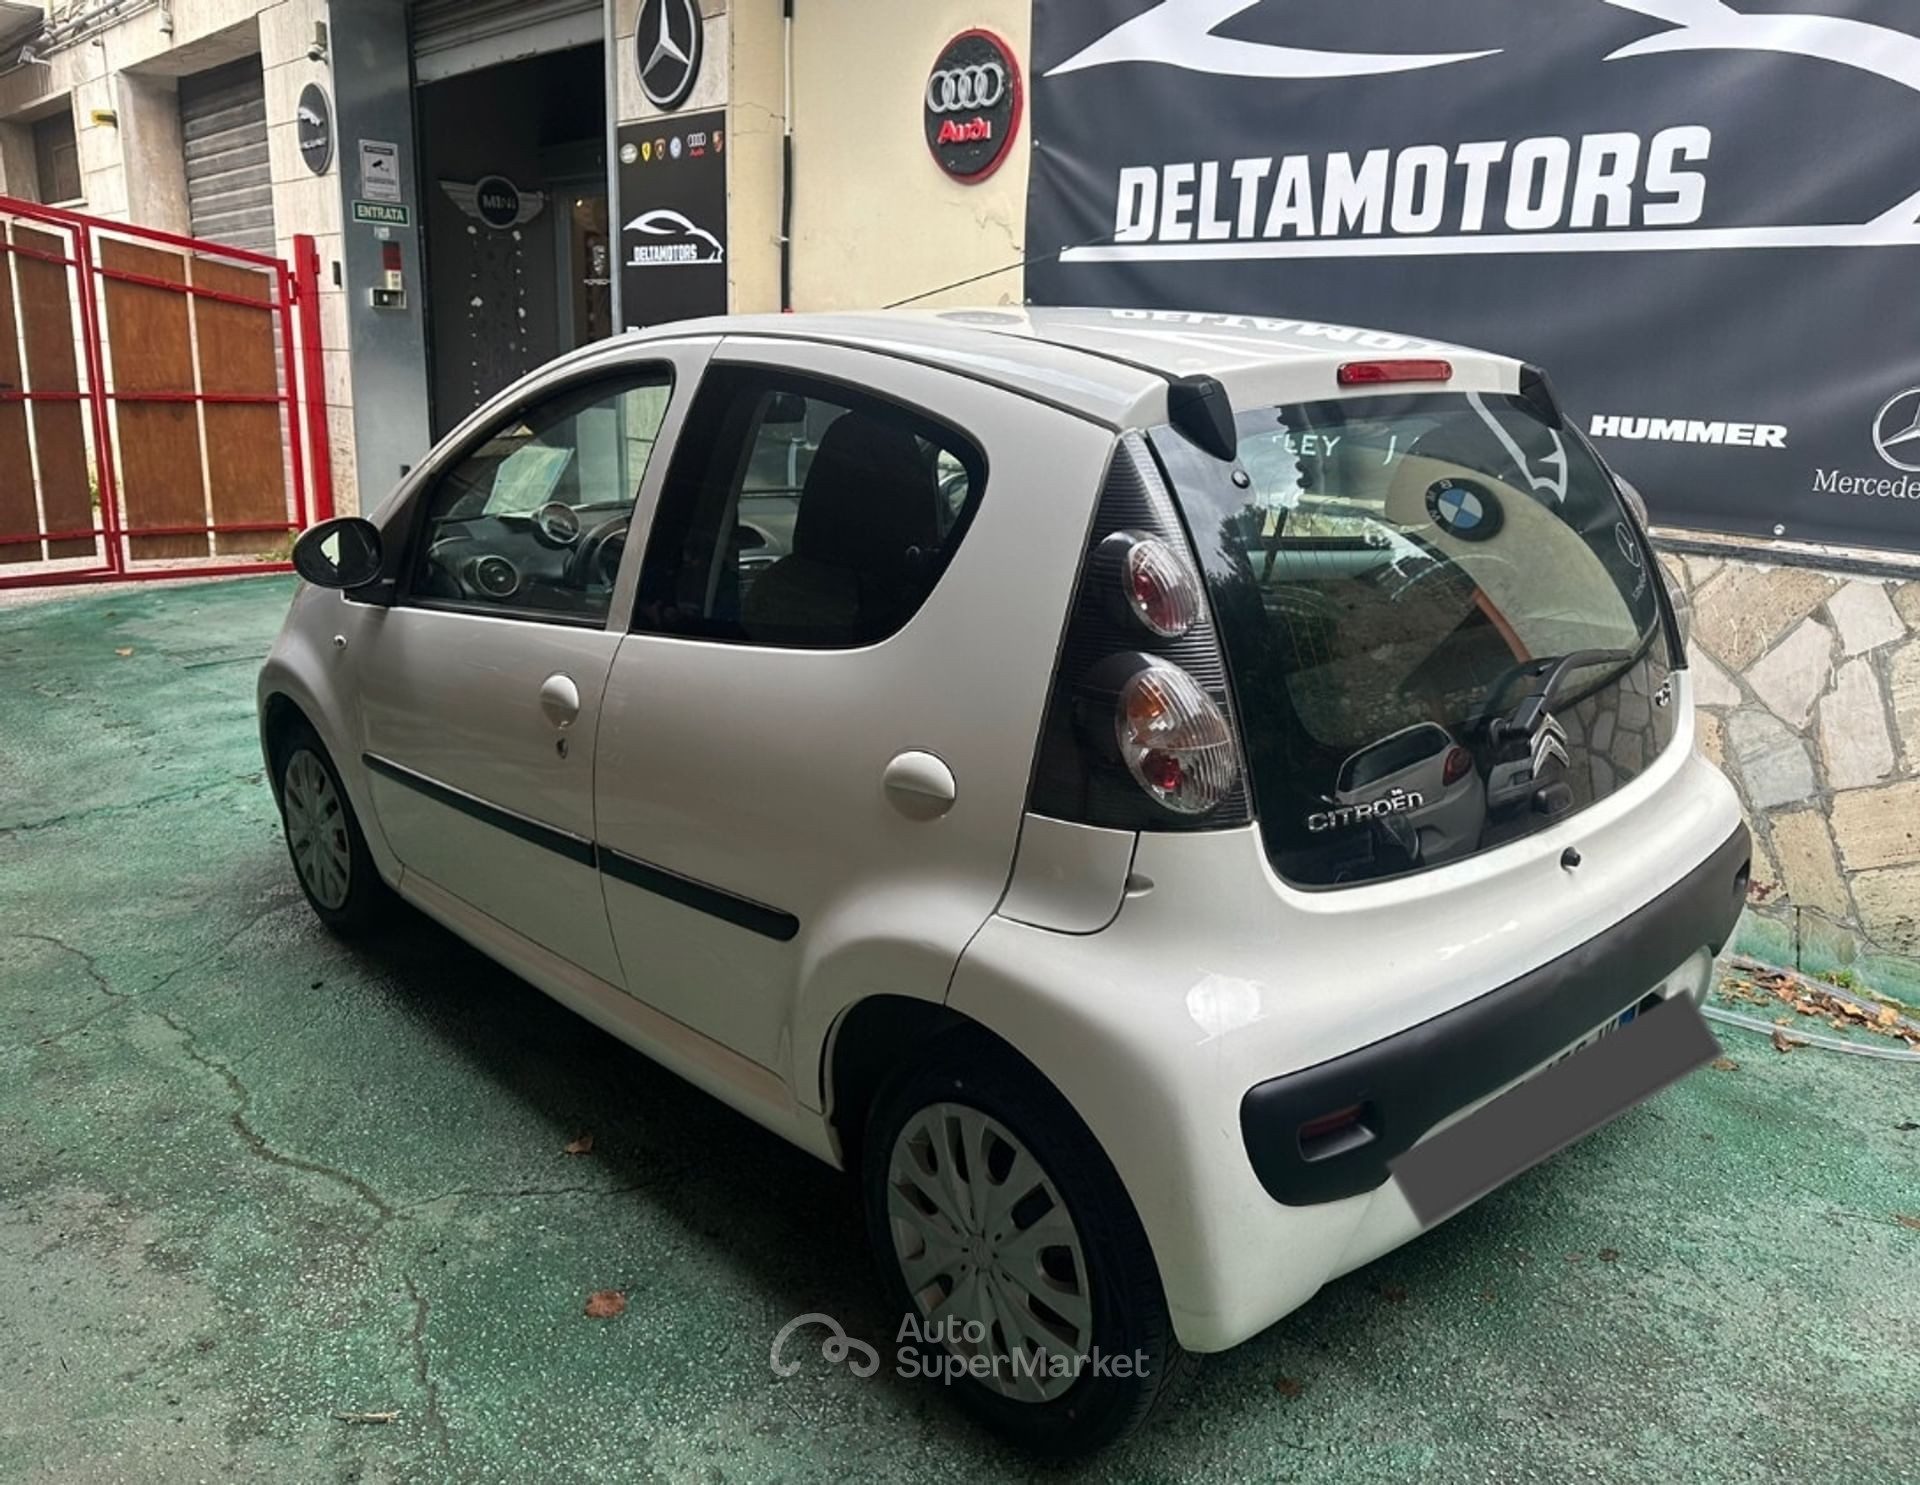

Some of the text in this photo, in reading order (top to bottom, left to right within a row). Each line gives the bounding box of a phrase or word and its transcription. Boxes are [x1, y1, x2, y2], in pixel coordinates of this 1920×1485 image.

[937, 117, 991, 144] Audi
[1114, 125, 1711, 242] DELTAMOTORS
[357, 204, 405, 221] ENTRATA
[633, 243, 698, 262] DELTAMOTORS
[1589, 414, 1788, 449] HUMMER
